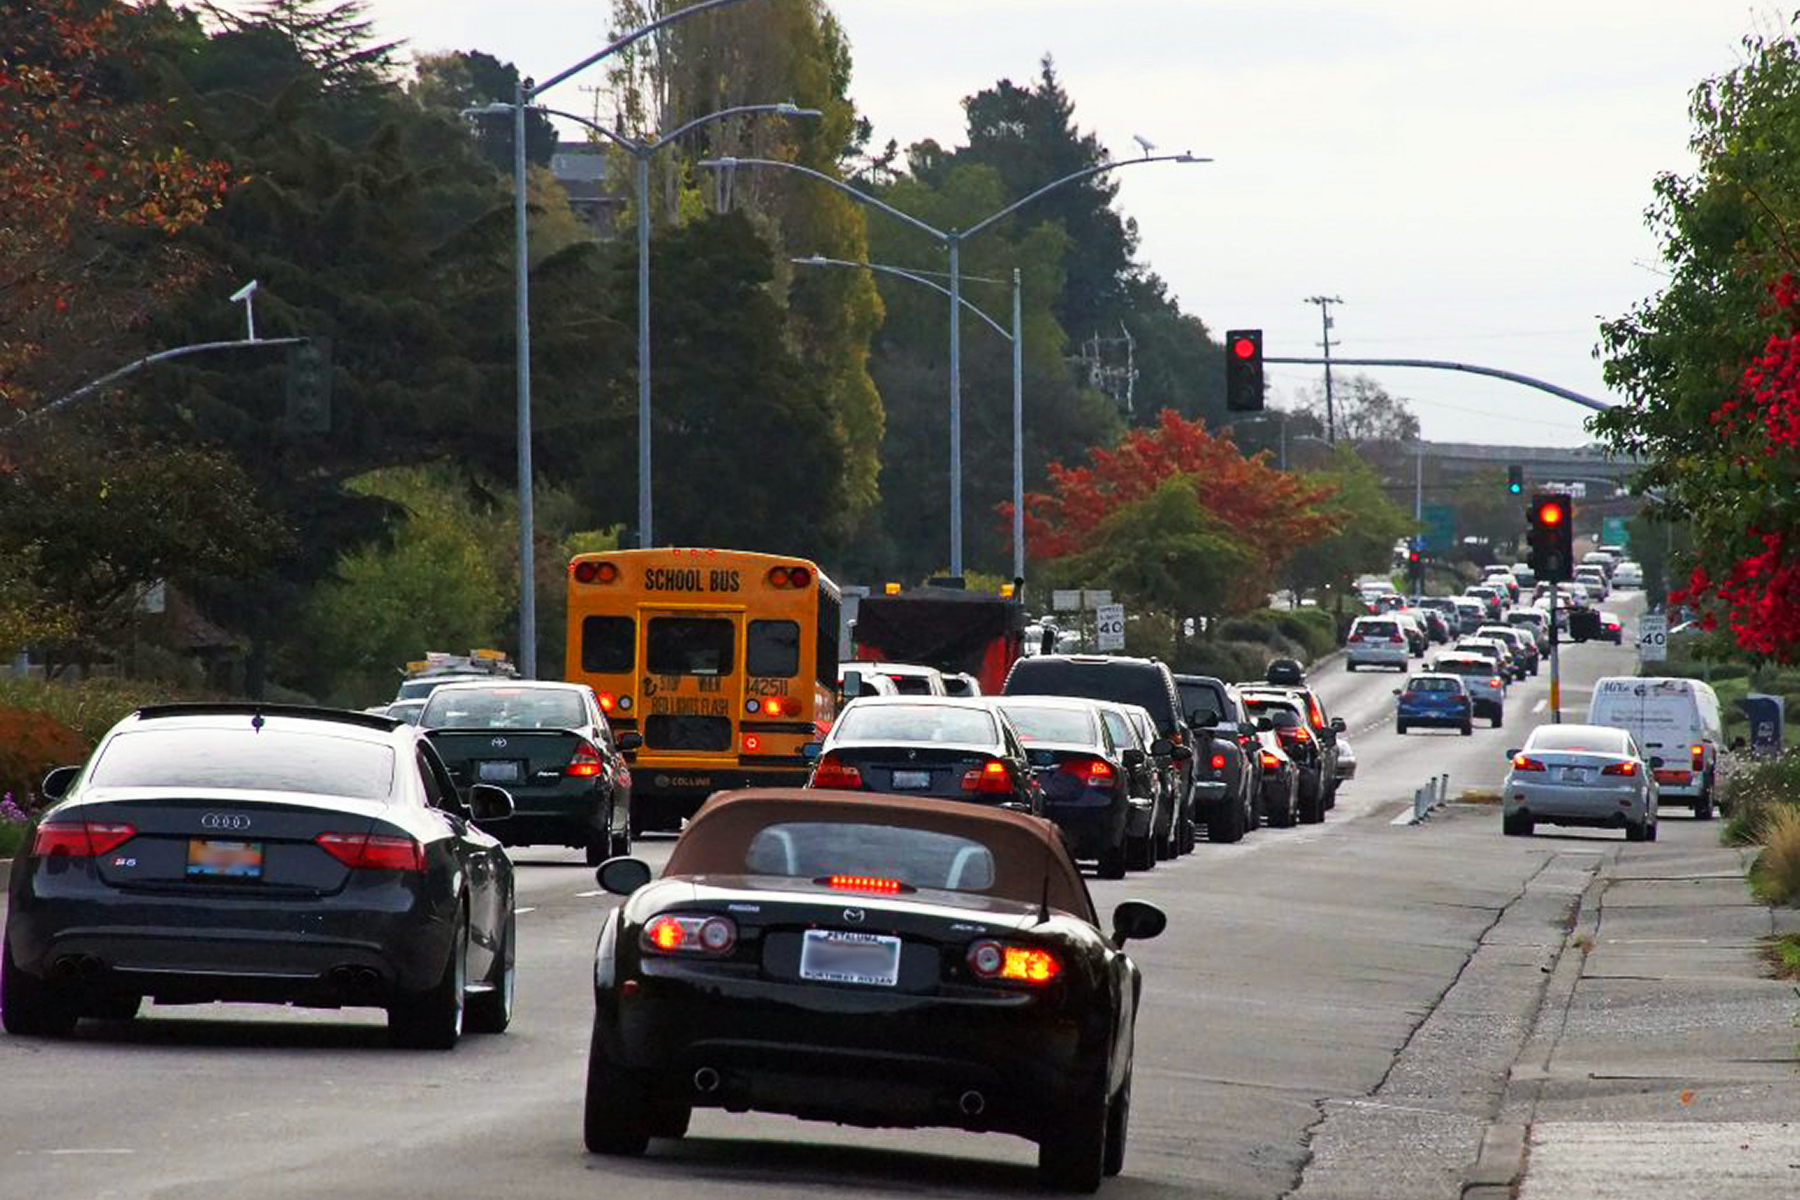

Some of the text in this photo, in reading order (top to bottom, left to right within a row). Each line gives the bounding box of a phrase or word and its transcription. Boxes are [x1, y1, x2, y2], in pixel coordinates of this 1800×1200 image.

[645, 568, 740, 593] SCHOOL BUS
[1099, 621, 1122, 634] 40
[1642, 633, 1665, 645] 40
